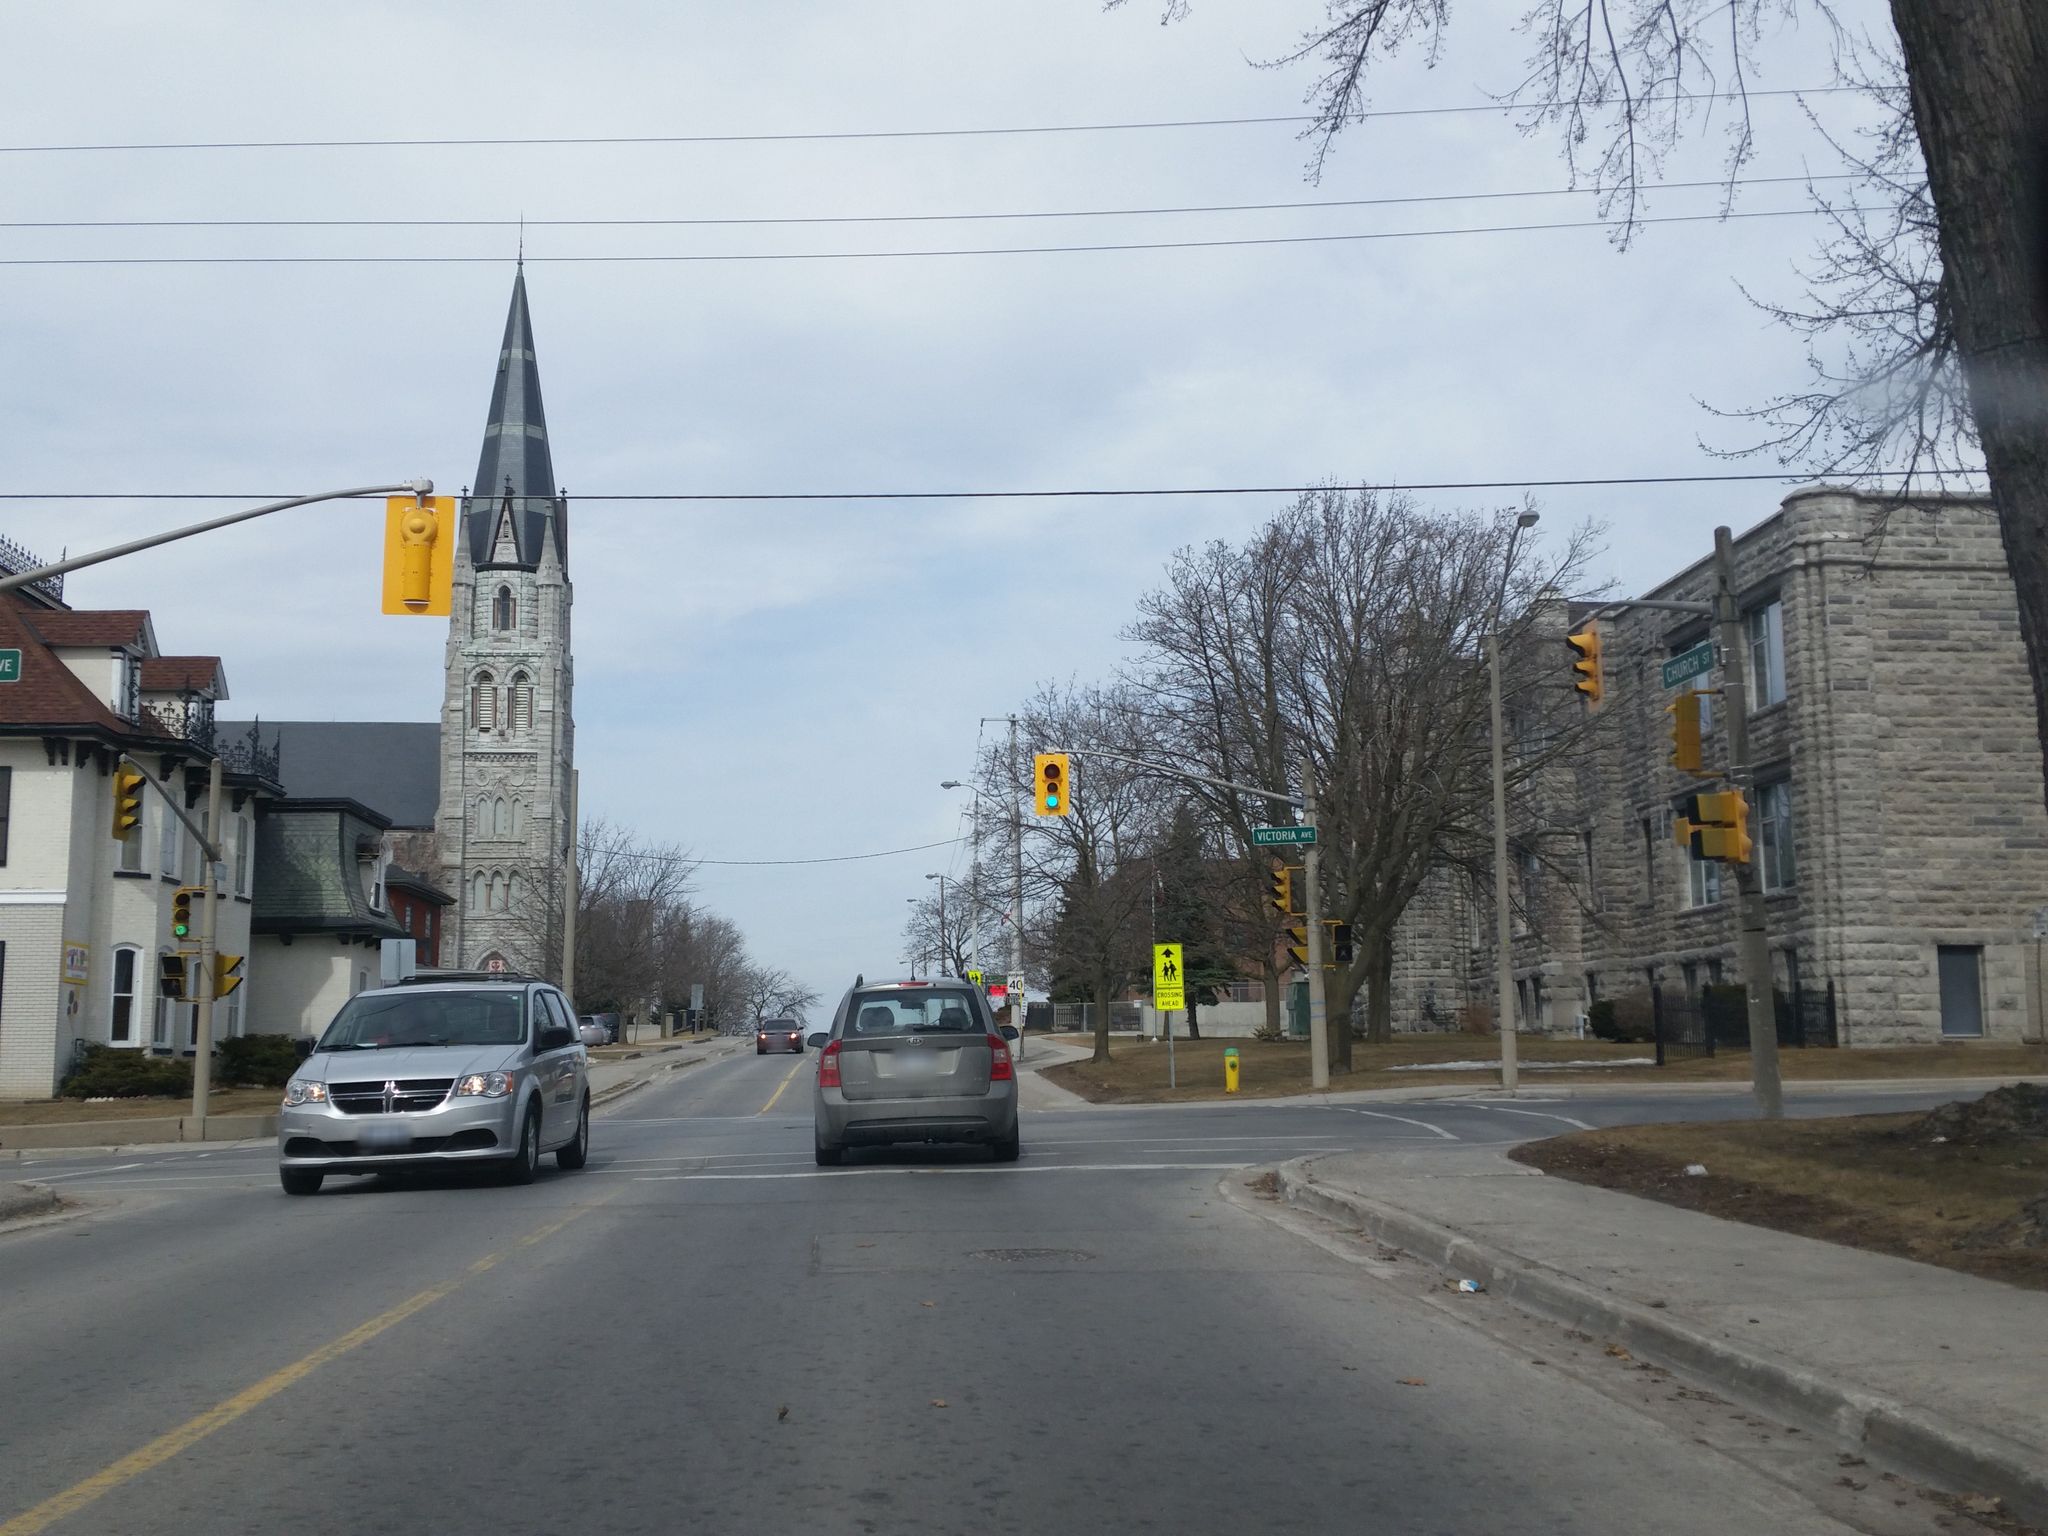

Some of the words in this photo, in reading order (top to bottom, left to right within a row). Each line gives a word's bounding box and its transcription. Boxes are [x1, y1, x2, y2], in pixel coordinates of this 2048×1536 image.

[1666, 655, 1699, 682] CHURCH
[1702, 651, 1710, 665] ST
[1257, 831, 1297, 841] VICTORIA
[1301, 831, 1313, 839] AVE
[1009, 980, 1022, 990] 40
[1157, 991, 1183, 999] CROSSING
